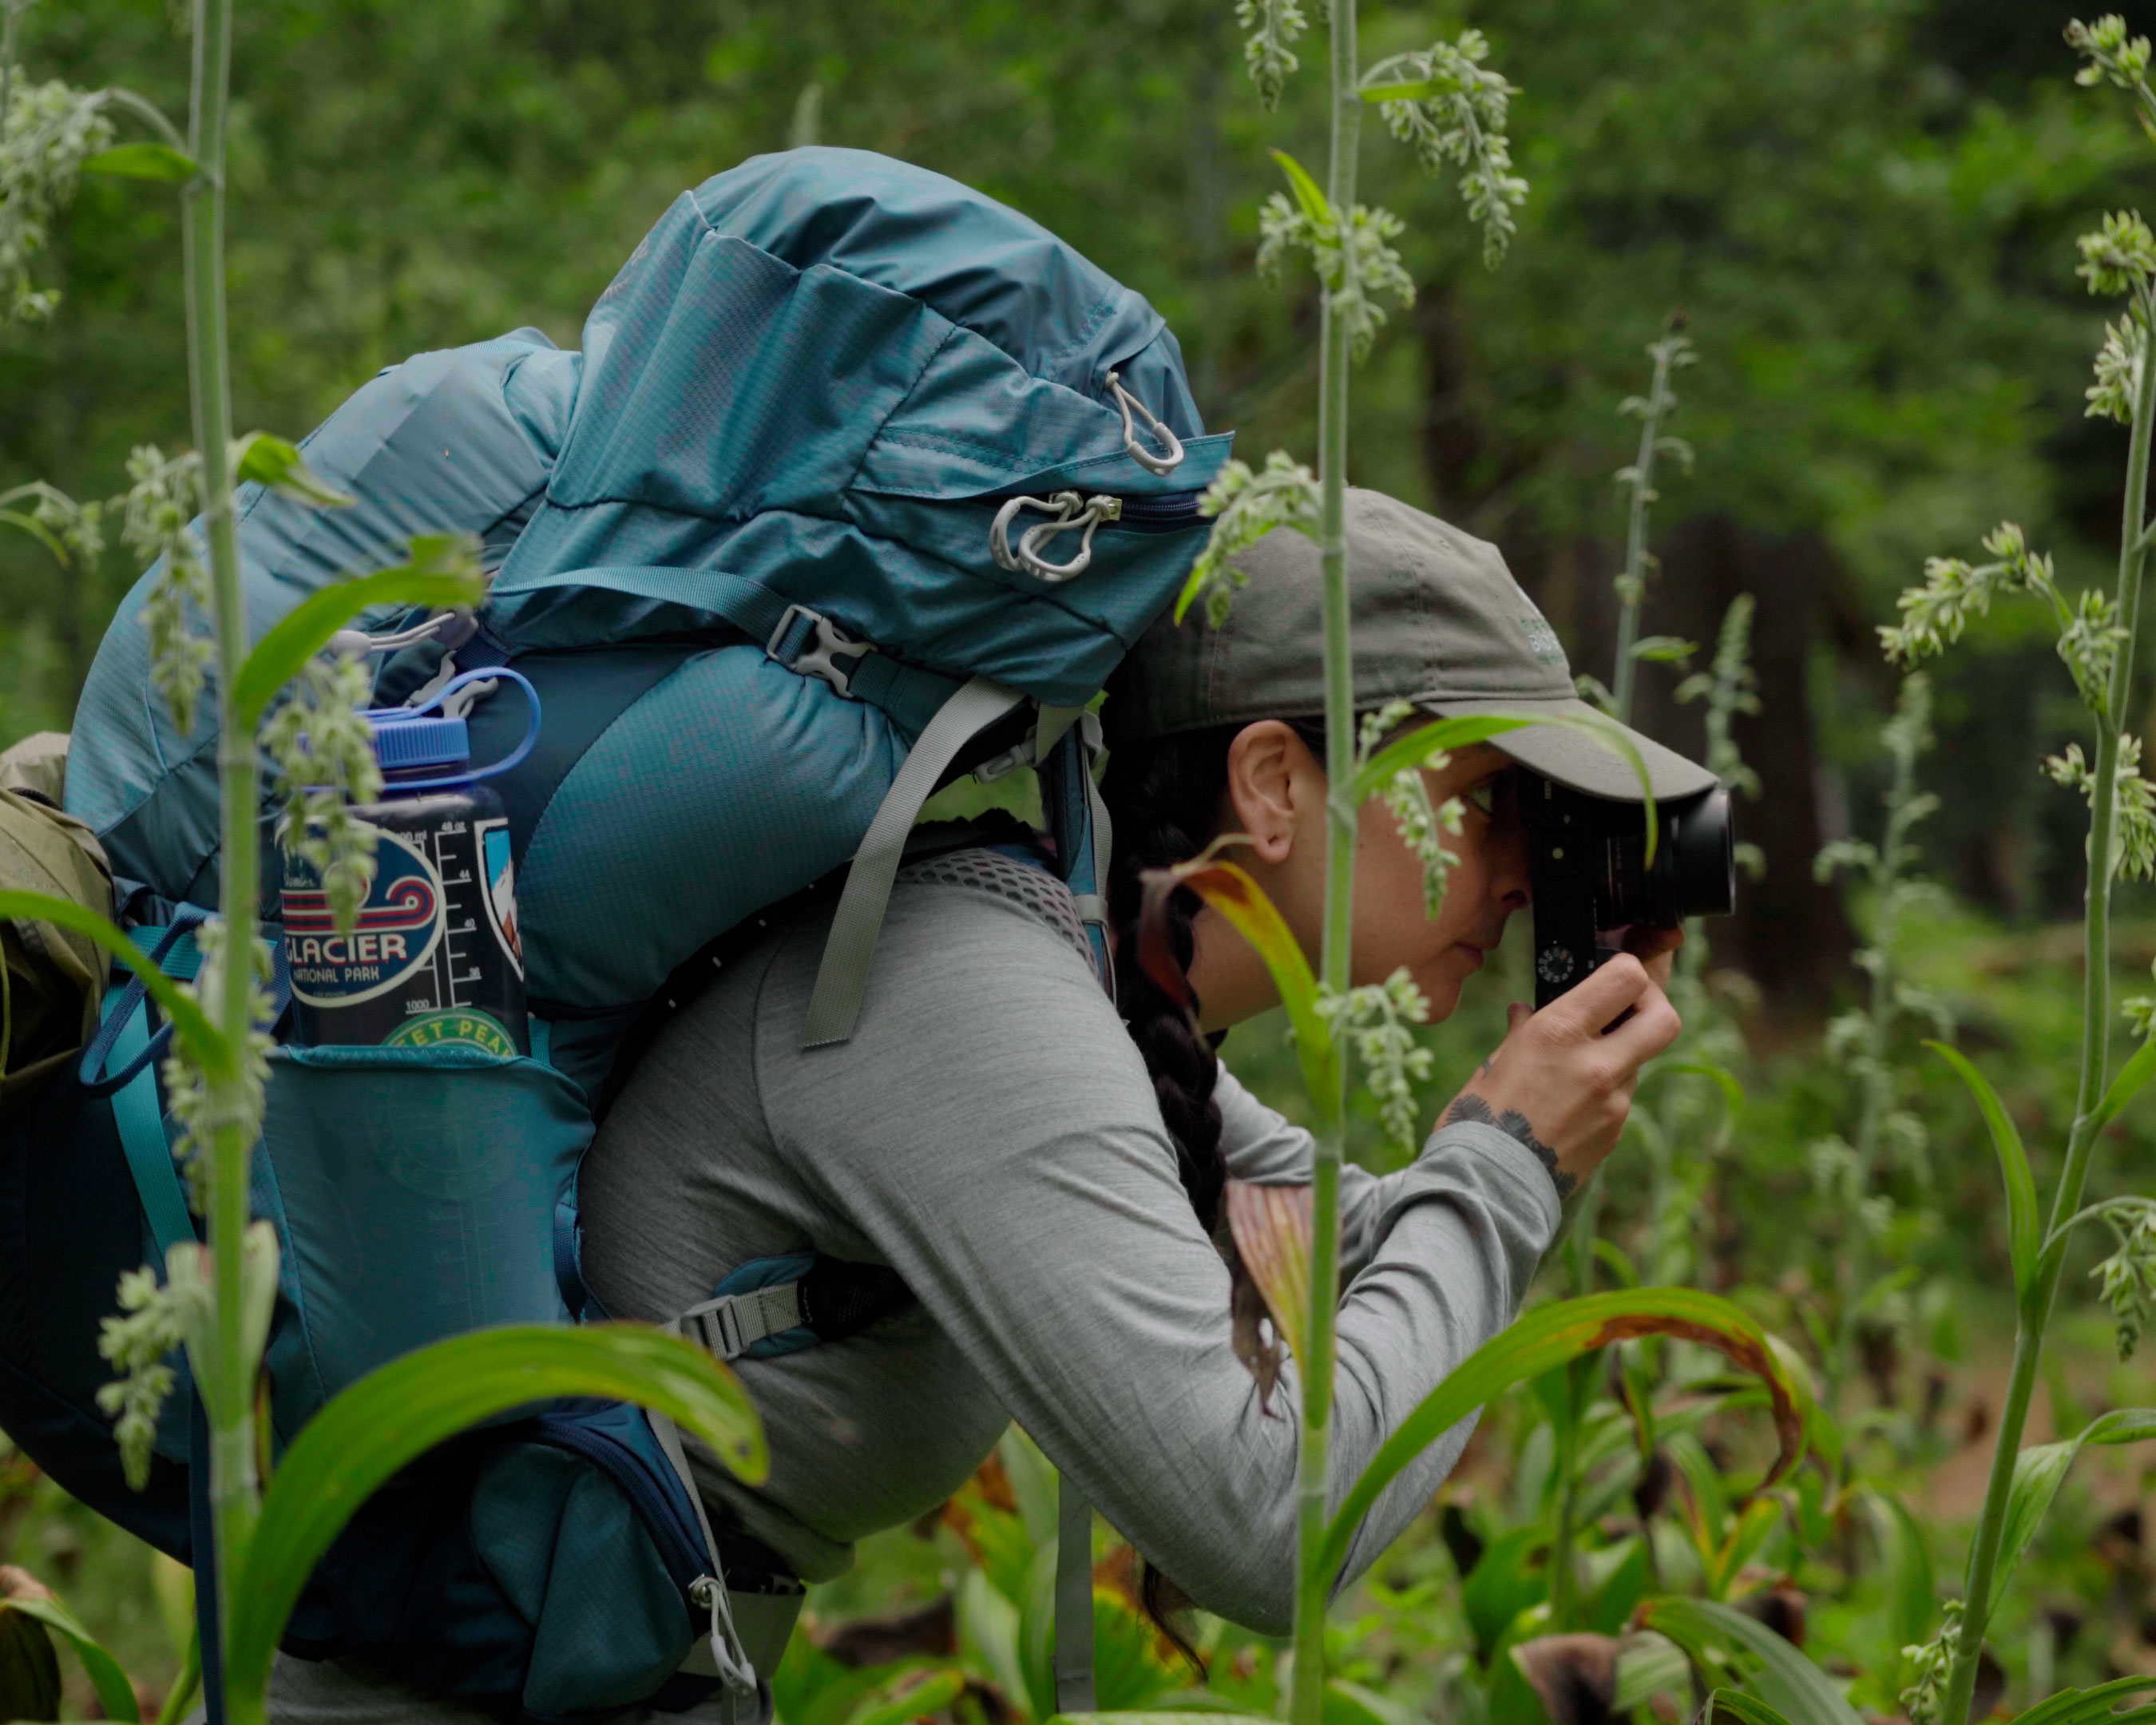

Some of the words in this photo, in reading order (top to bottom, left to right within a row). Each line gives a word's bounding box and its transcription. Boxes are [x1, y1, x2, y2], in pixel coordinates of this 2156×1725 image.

[414, 830, 427, 841] ml
[458, 869, 470, 879] 44
[464, 918, 475, 929] 40
[285, 933, 409, 966] GLACIER
[293, 967, 339, 984] NATIONAL
[344, 966, 380, 981] PARK
[405, 999, 430, 1011] 1000
